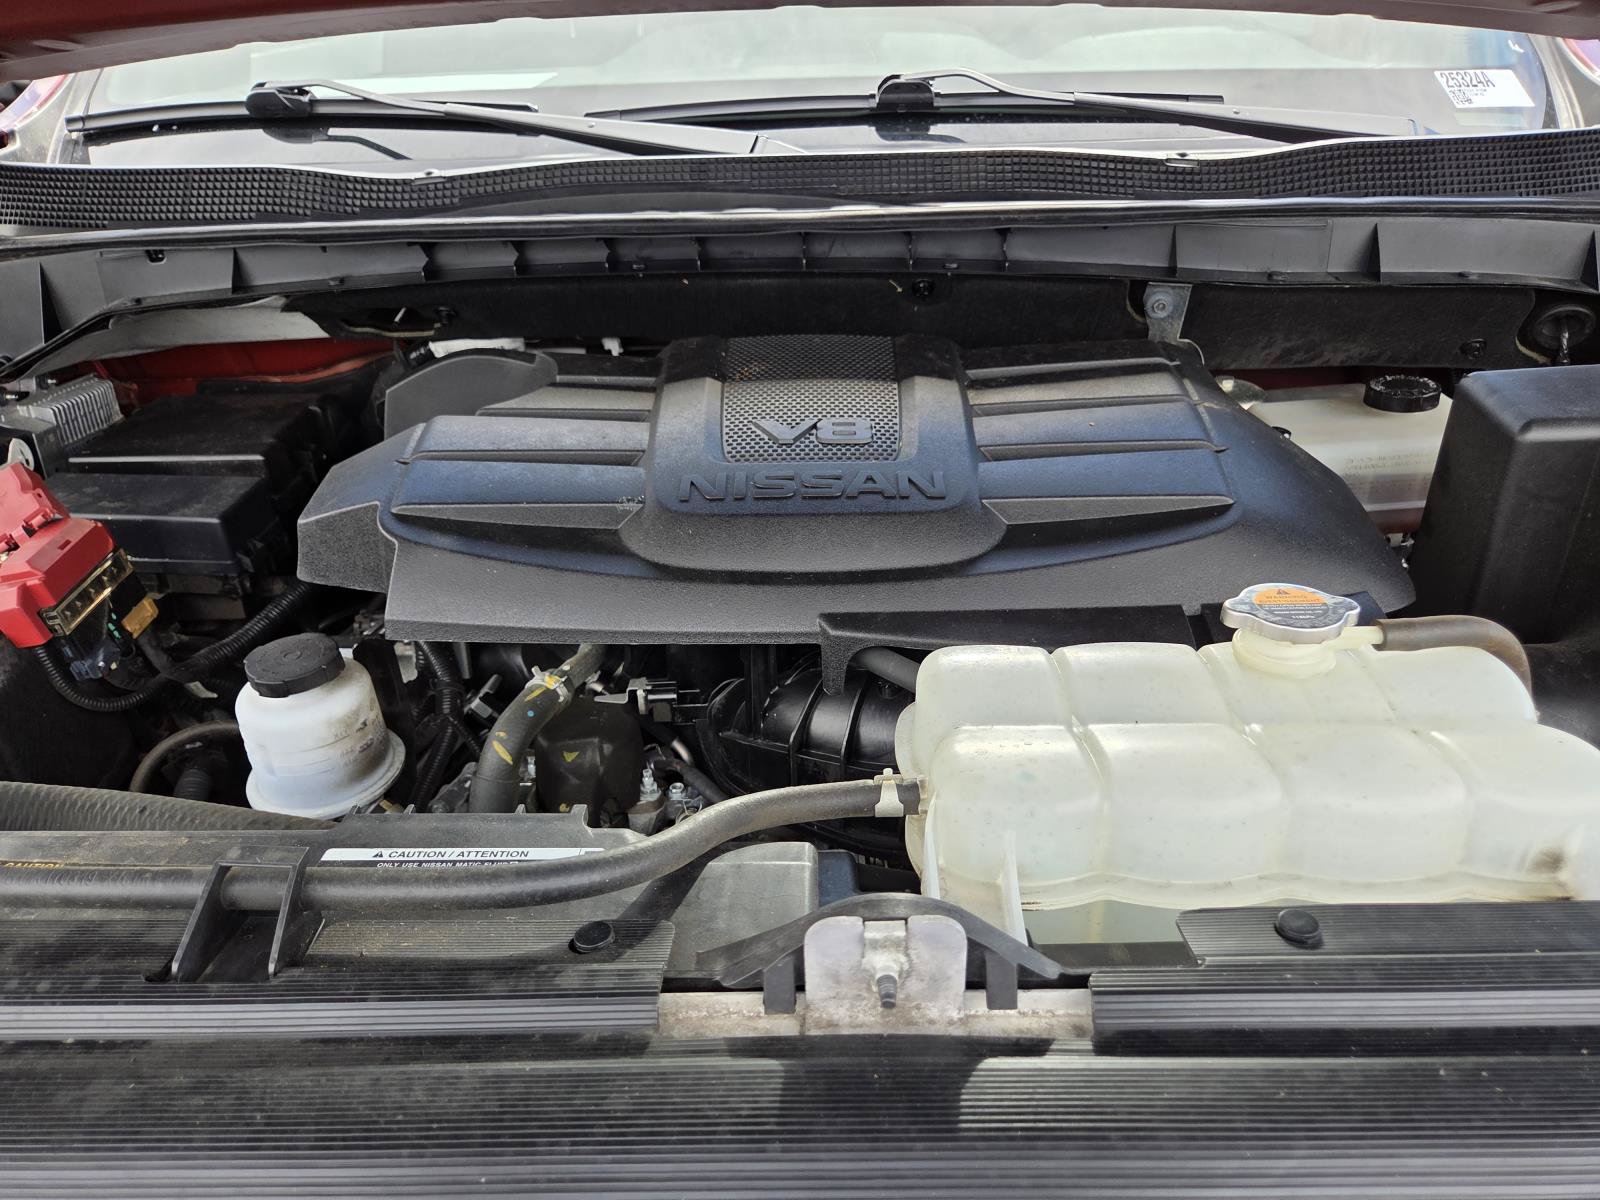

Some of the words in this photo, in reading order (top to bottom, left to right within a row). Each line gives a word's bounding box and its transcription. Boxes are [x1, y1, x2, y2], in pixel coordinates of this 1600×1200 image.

[1440, 71, 1495, 88] 25324A
[752, 417, 873, 445] V8
[679, 470, 946, 502] NISSAN
[388, 850, 447, 858] CAUTION
[456, 850, 529, 858] ATTENTION
